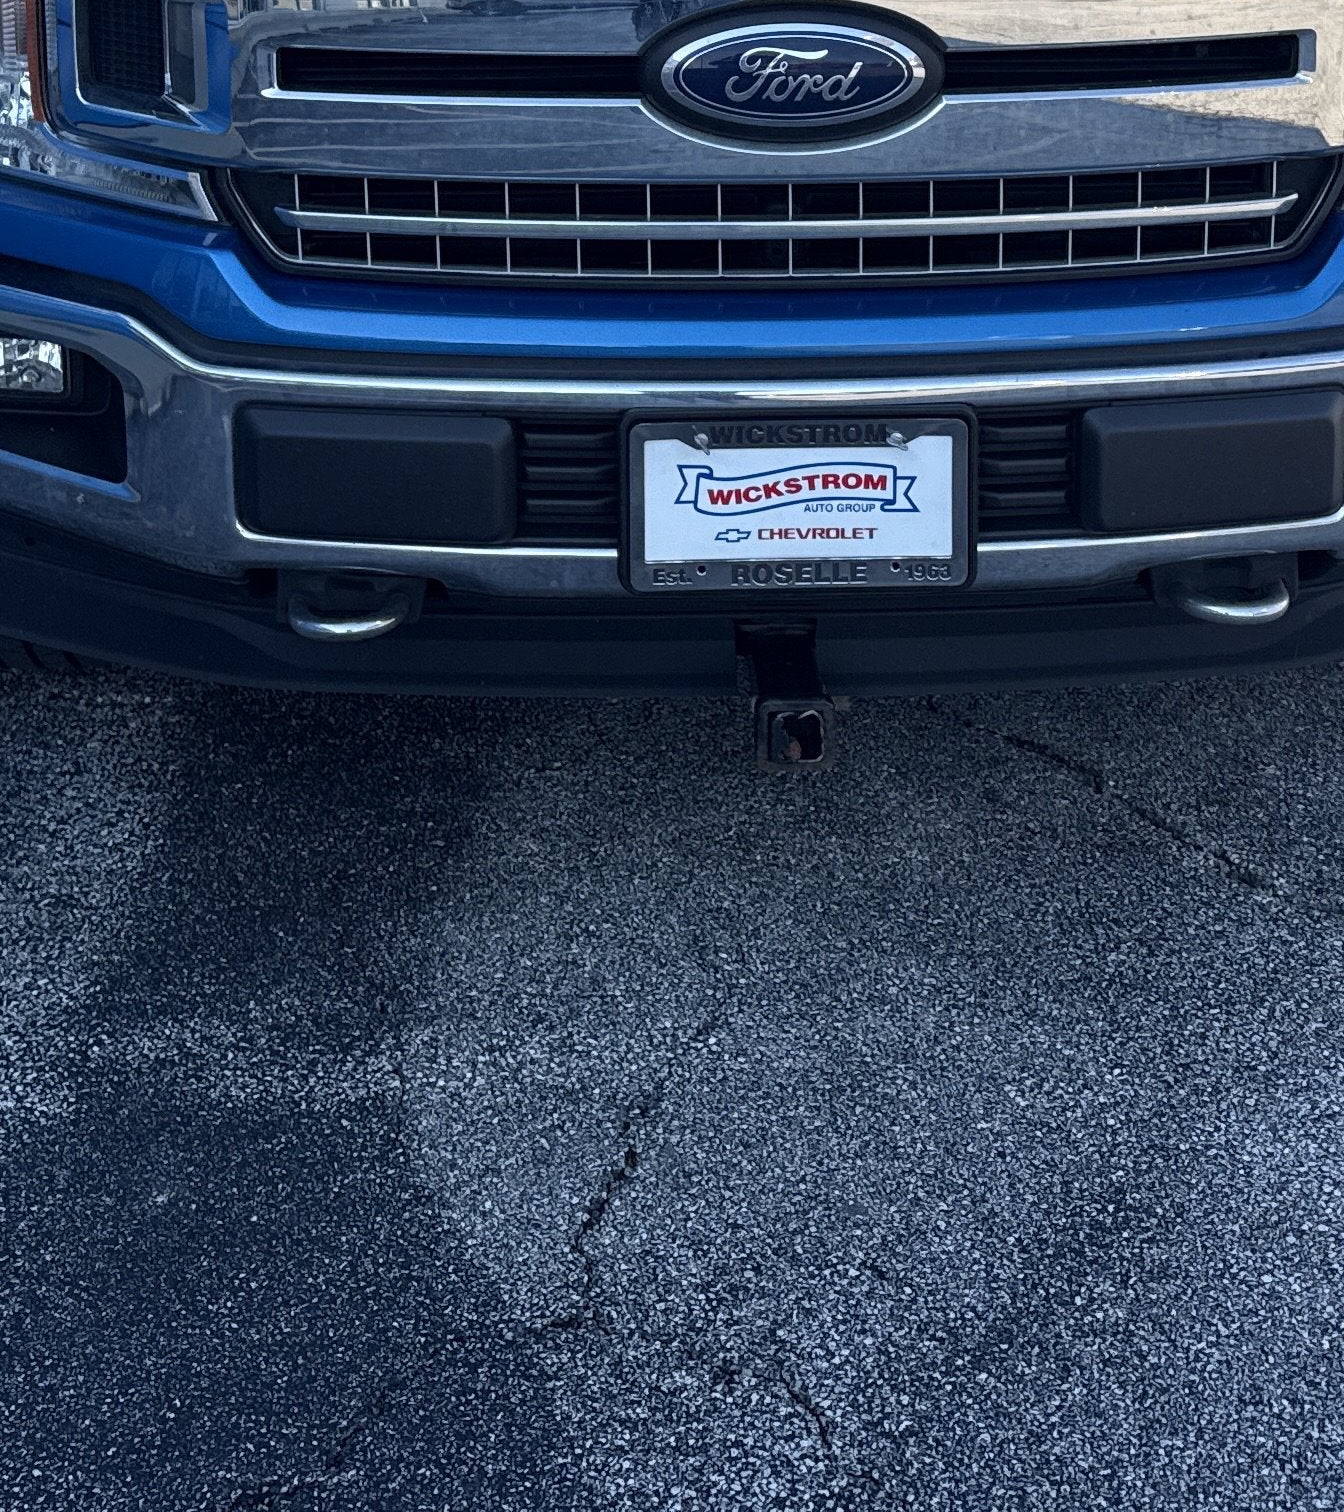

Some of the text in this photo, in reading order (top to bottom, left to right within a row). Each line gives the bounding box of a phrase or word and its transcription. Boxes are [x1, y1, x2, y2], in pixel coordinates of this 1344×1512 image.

[725, 46, 863, 102] Ford
[709, 424, 888, 445] WICKSTROM
[707, 473, 887, 505] WICKSTROM
[803, 503, 876, 513] AUTO GROUP
[757, 527, 878, 541] CHEVROLET
[653, 568, 693, 586] Est.
[731, 562, 867, 587] ROSELLE
